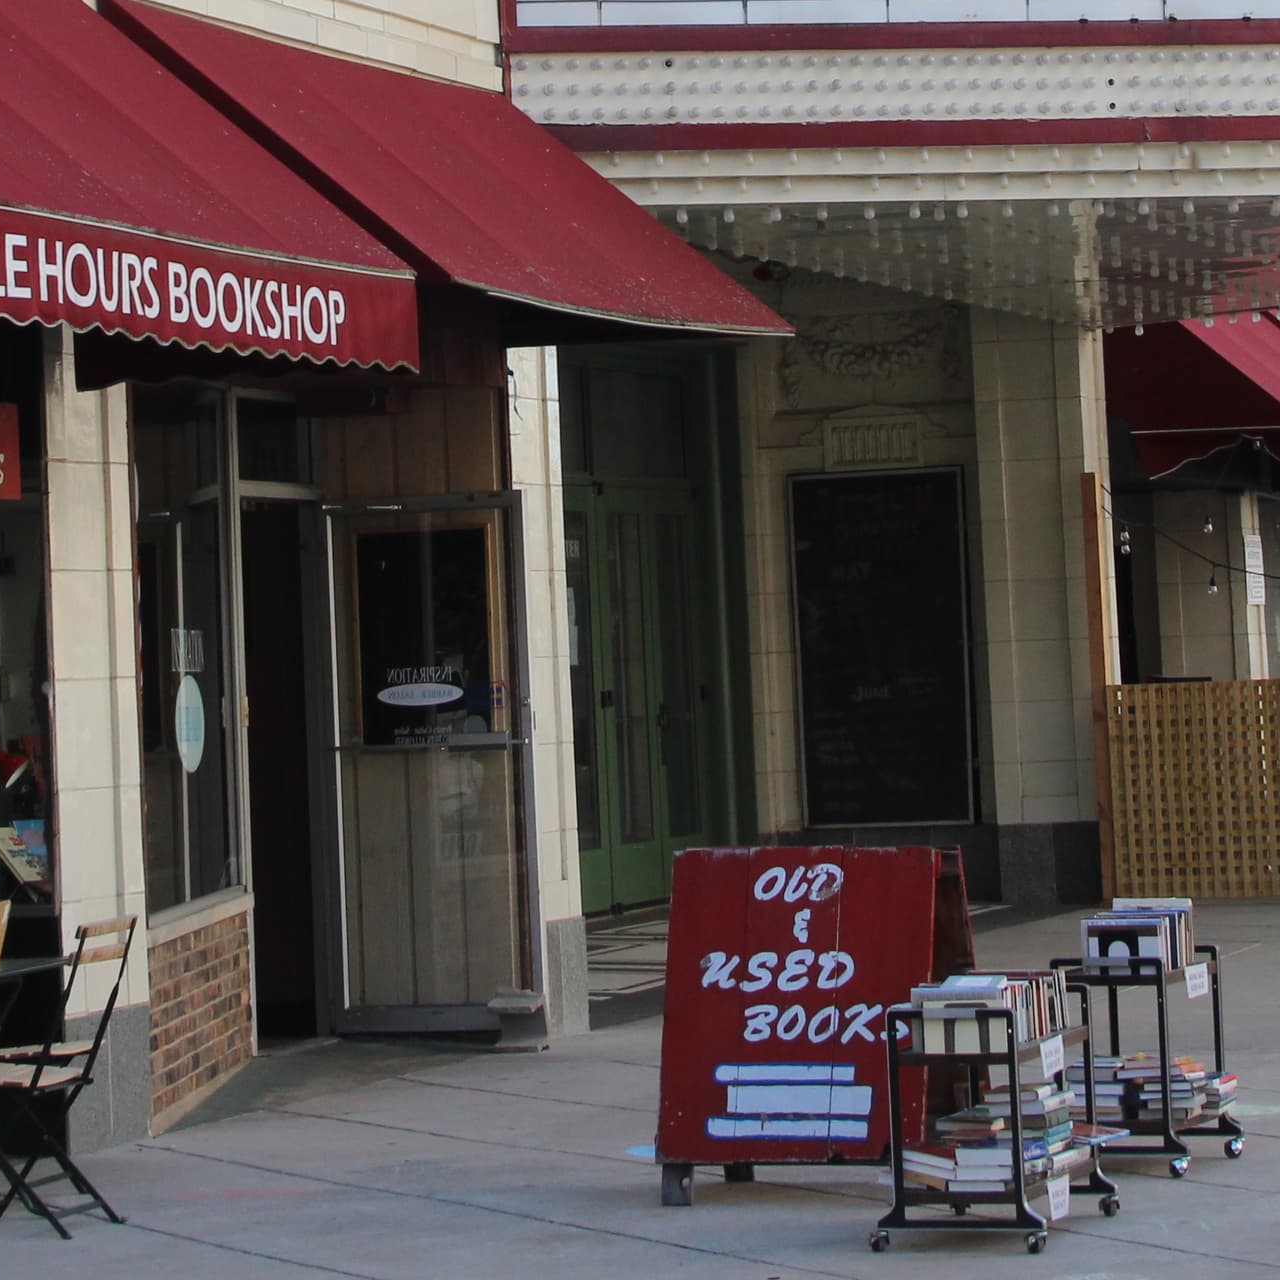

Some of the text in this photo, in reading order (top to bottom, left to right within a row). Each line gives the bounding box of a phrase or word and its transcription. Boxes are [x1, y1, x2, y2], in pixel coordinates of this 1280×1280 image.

[39, 238, 160, 319] HOURS
[167, 261, 346, 346] BOOKSHOP
[754, 863, 844, 903] OLD
[700, 949, 855, 992] USED
